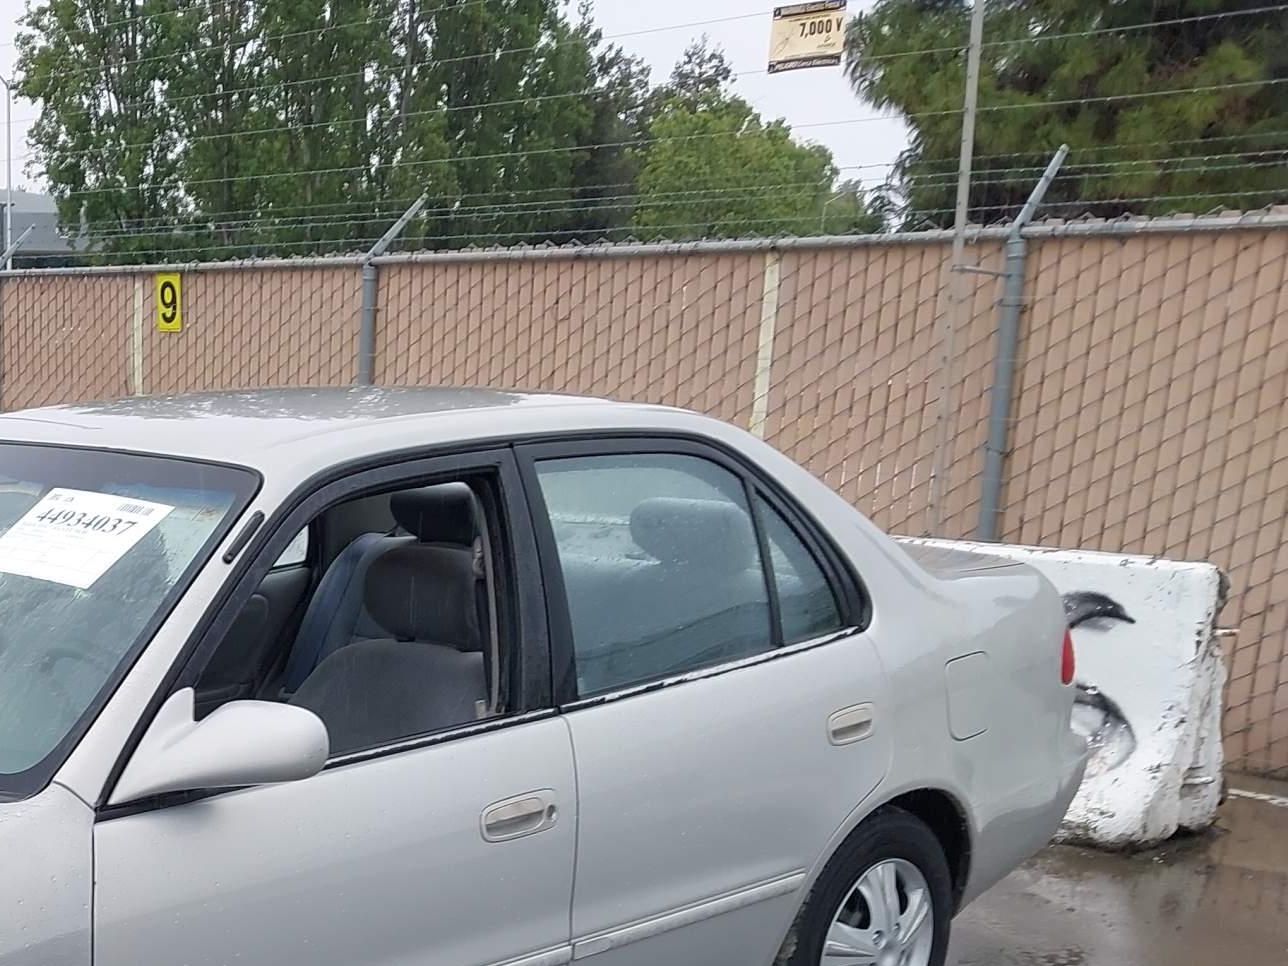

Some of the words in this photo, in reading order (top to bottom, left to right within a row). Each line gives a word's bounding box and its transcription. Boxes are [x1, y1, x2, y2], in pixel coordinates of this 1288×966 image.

[799, 19, 832, 38] 7,000
[836, 17, 843, 31] V
[160, 281, 177, 324] 9
[36, 508, 138, 536] 44934037
